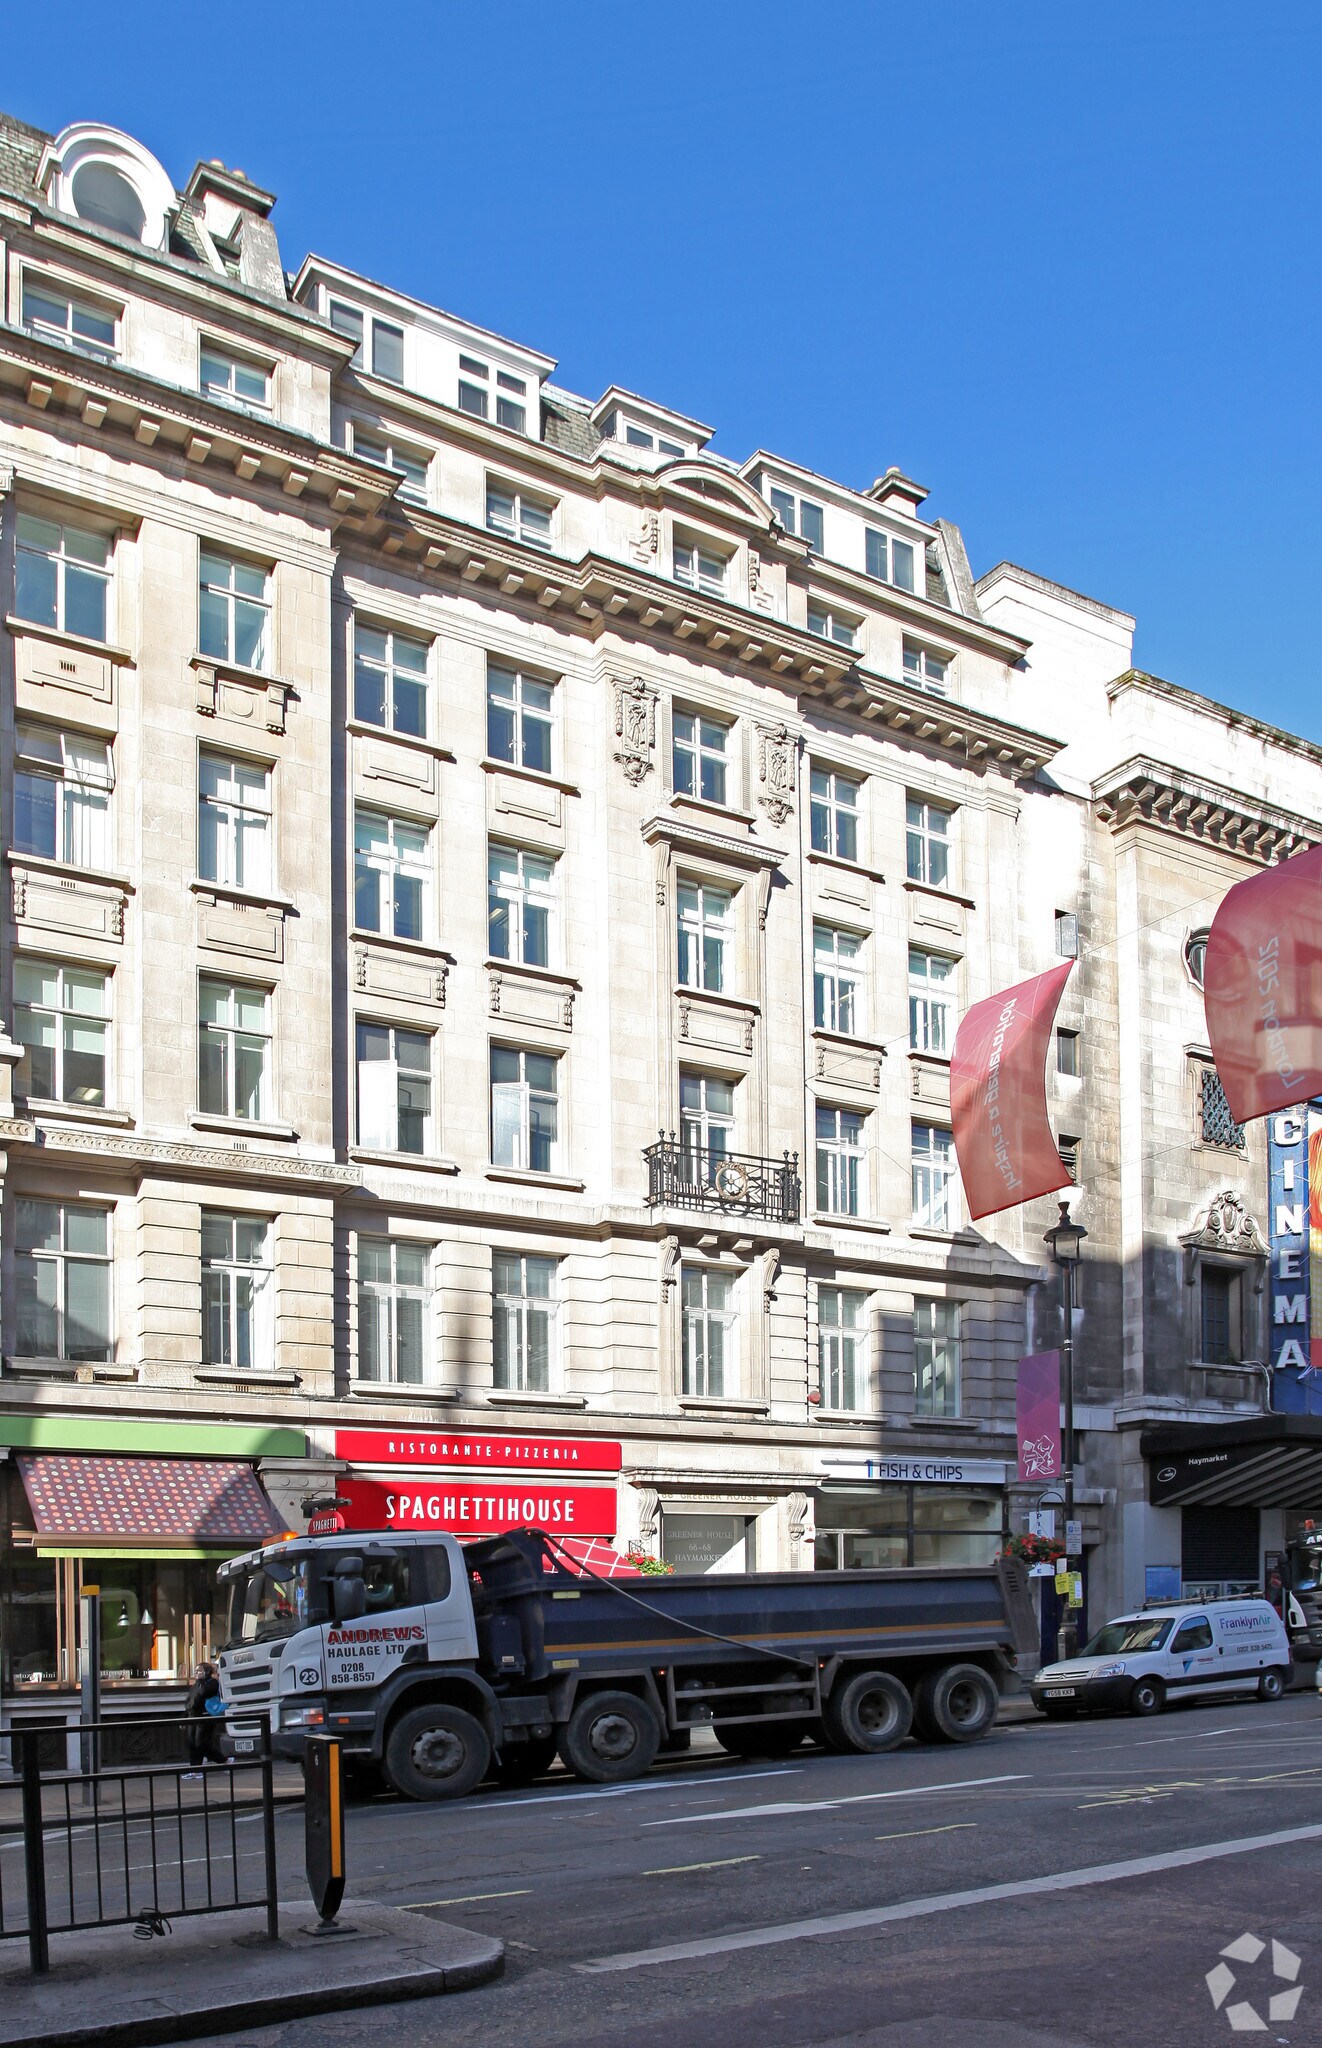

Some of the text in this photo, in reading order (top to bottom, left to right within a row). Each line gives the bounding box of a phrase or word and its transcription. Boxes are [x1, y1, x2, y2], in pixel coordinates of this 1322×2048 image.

[1274, 1115, 1307, 1369] CINEMA
[388, 1441, 579, 1460] RISTORANTE PIZZERIA
[1188, 1454, 1228, 1465] Haymarket
[879, 1462, 908, 1478] FISH
[912, 1464, 922, 1479] &
[925, 1465, 963, 1480] CHIPS
[386, 1494, 575, 1522] SPAGHETTIHOUSE
[312, 1517, 338, 1532] SPAGHETTI
[667, 1530, 733, 1539] GREENER HOUSE
[675, 1553, 725, 1562] HAYMARKE
[327, 1626, 425, 1645] ANDREWS
[327, 1644, 405, 1658] HAULAGE LTD
[341, 1662, 365, 1673] 0208
[301, 1671, 317, 1683] 23
[331, 1671, 376, 1684] 858-8557
[314, 1754, 319, 1766] 6
